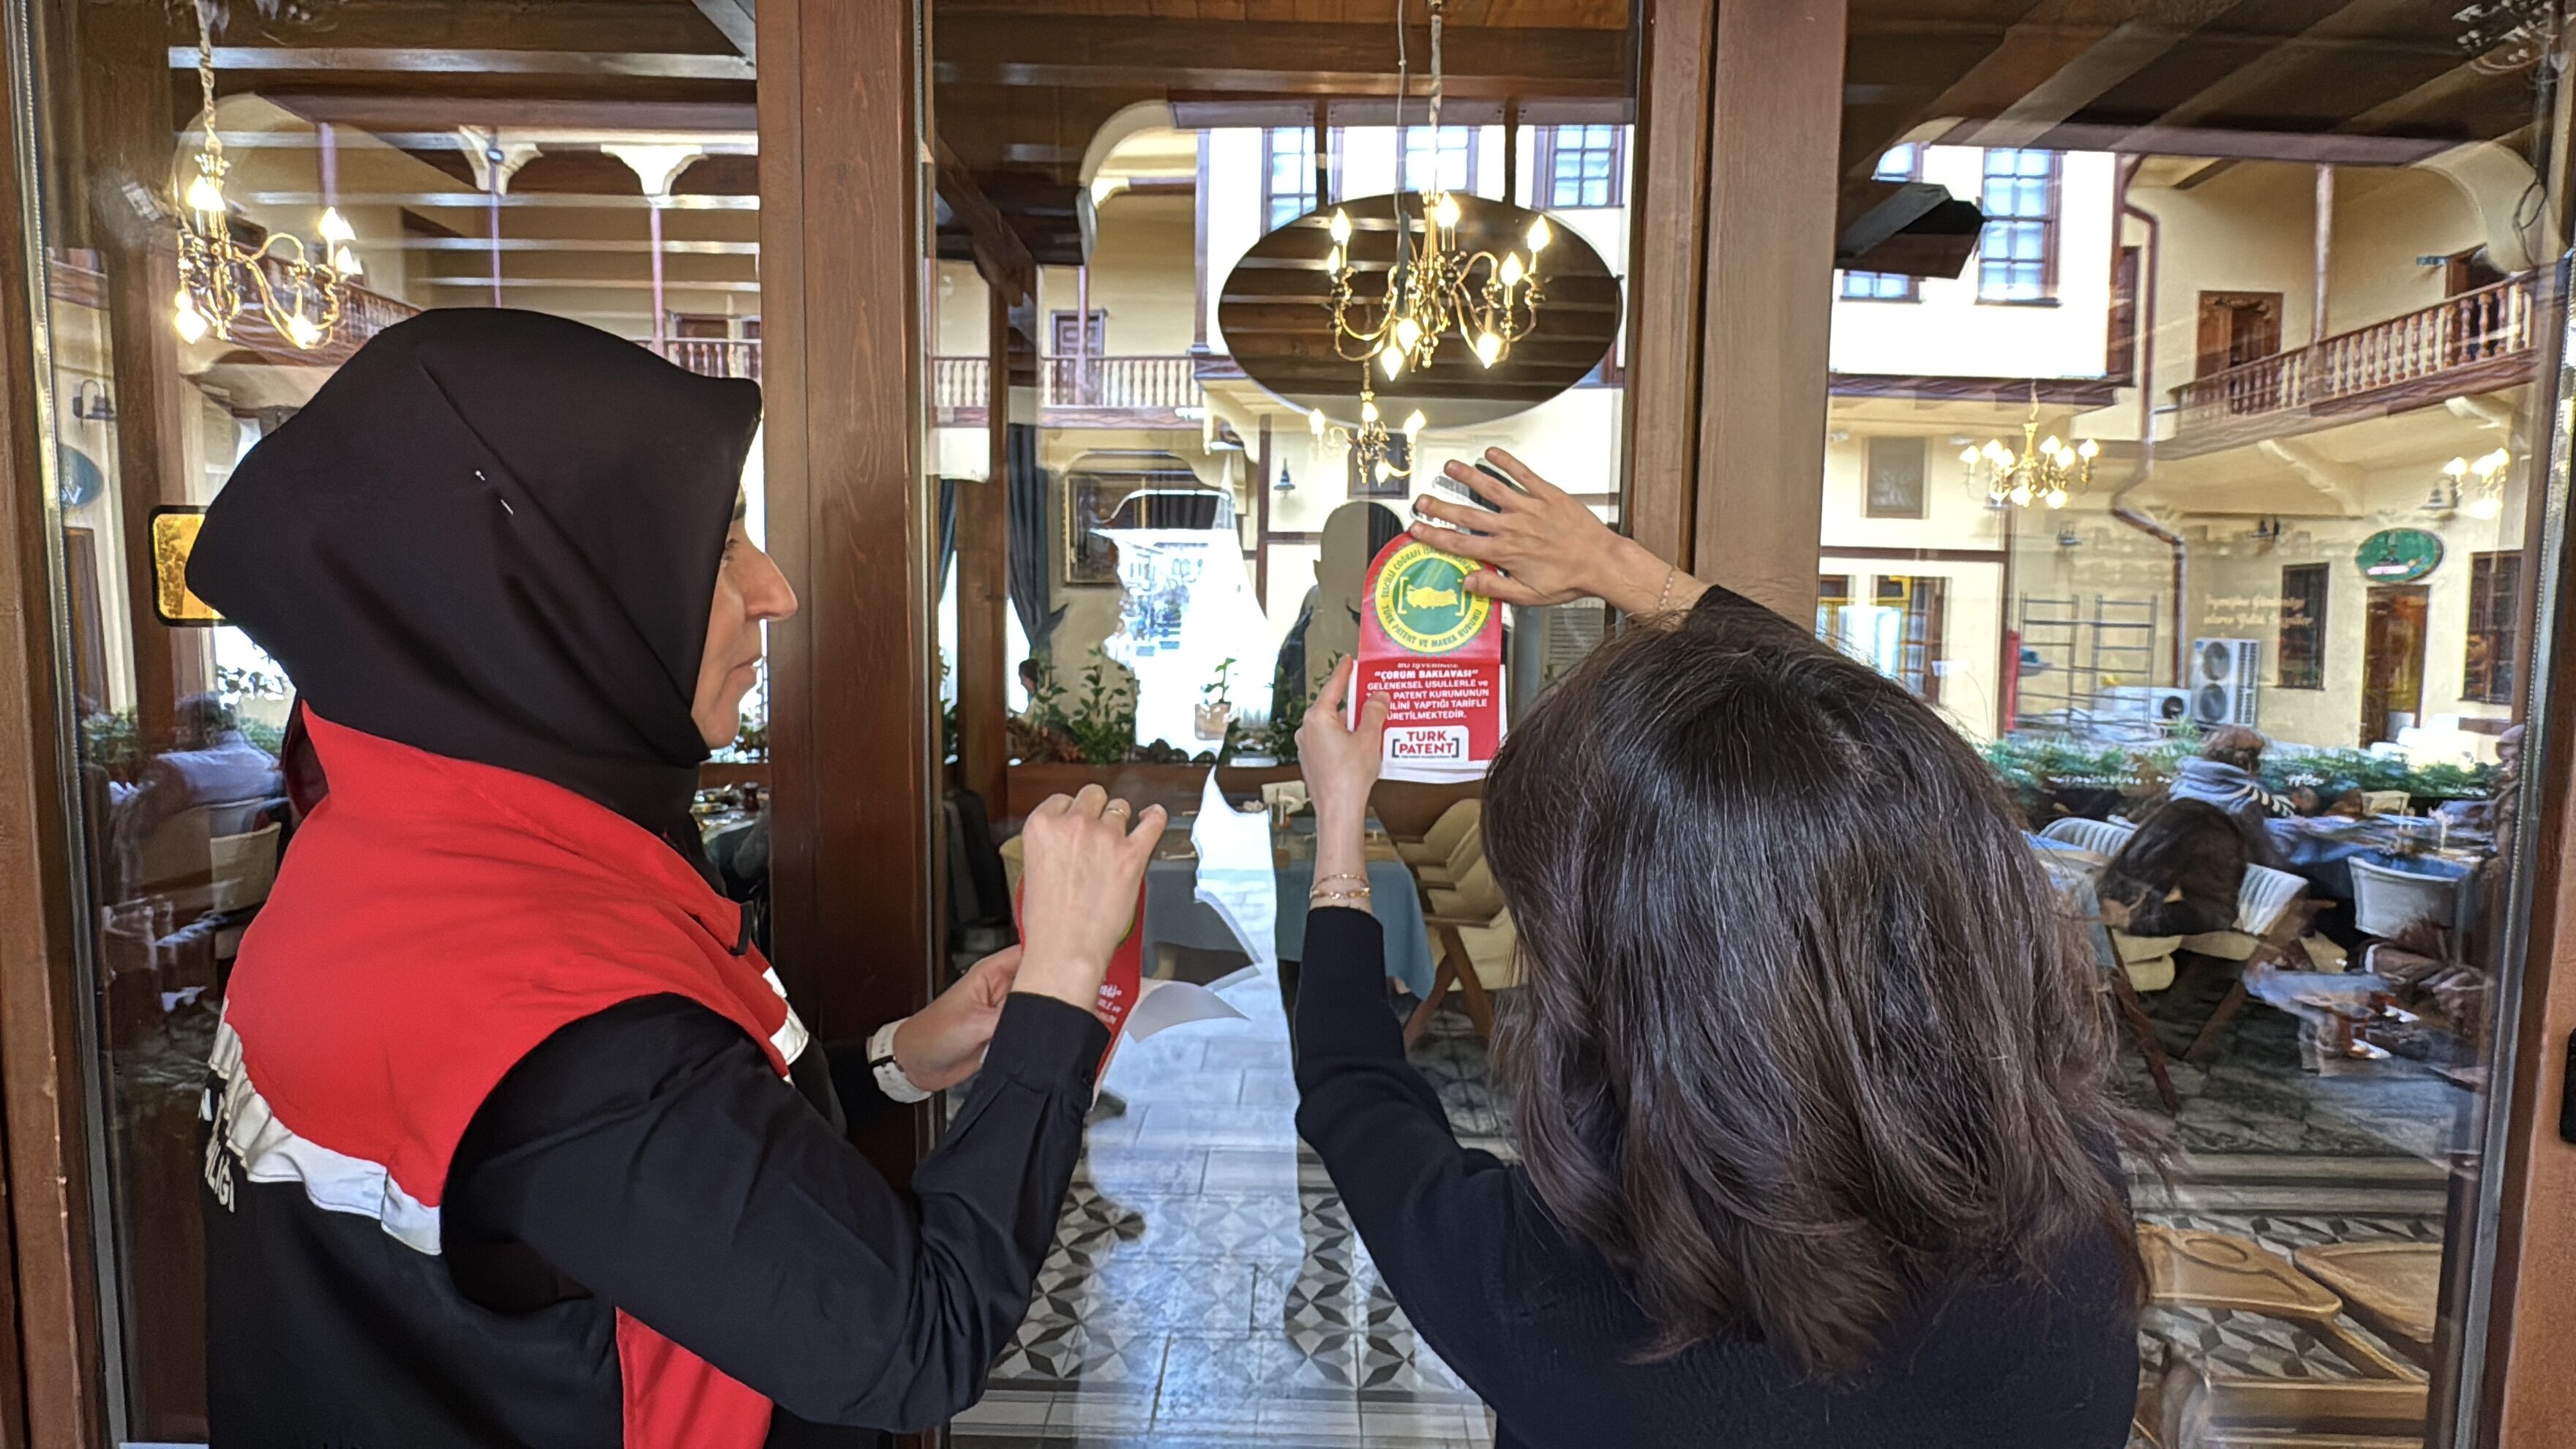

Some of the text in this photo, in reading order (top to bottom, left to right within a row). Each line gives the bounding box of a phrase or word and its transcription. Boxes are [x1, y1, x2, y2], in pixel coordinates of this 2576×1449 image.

[1392, 624, 1417, 644] PATENT
[1419, 639, 1429, 648] VE
[1458, 609, 1482, 638] KURUMU
[1367, 681, 1423, 690] GELENEKSEL
[1425, 679, 1476, 689] USULLERLE
[1393, 689, 1489, 700] PATENT KURUMUNUN
[1414, 700, 1449, 709] YAPTIĞI
[1451, 698, 1487, 708] TARİFLE
[1399, 743, 1453, 754] PATENT
